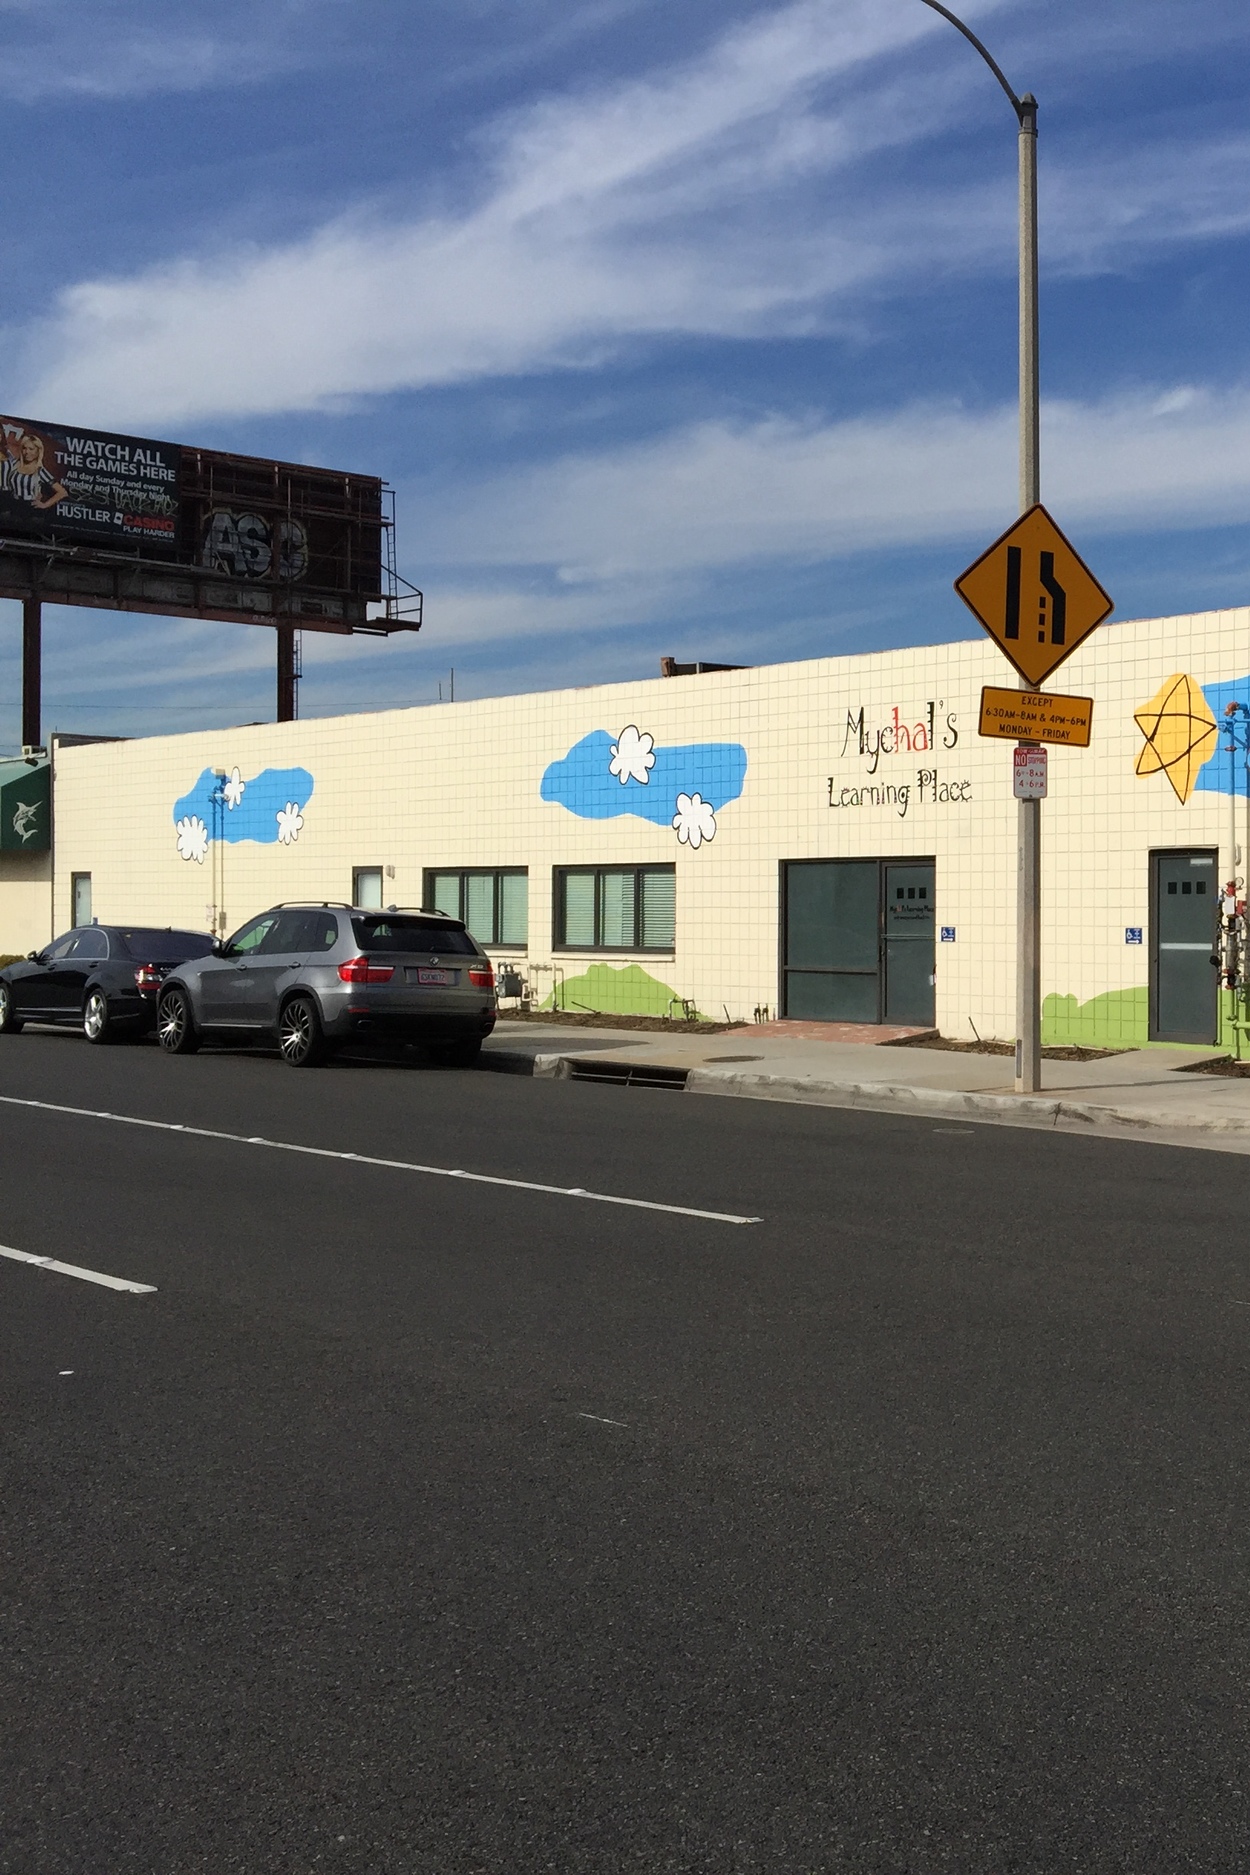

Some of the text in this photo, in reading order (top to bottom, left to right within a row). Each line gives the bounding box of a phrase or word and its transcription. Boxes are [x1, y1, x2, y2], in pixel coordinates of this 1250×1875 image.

[66, 436, 166, 467] WATCH ALL
[54, 451, 176, 482] THE GAMES HERE
[60, 478, 93, 491] Monday
[94, 482, 110, 493] and
[111, 485, 148, 500] Thursday
[66, 470, 165, 493] All day Sunday and every
[56, 504, 111, 521] HUSTLER
[123, 514, 175, 531] CASINO
[123, 525, 141, 534] PLAY
[143, 528, 175, 539] HARDER
[1021, 696, 1054, 708] EXCEPT
[1039, 713, 1046, 722] &
[1050, 714, 1087, 726] 4PM-6PM
[841, 700, 958, 774] Mychal's
[999, 724, 1033, 736] MONDAY
[1042, 728, 1071, 739] FRIDAY
[1015, 754, 1027, 766] NO
[827, 769, 972, 818] Learning Place
